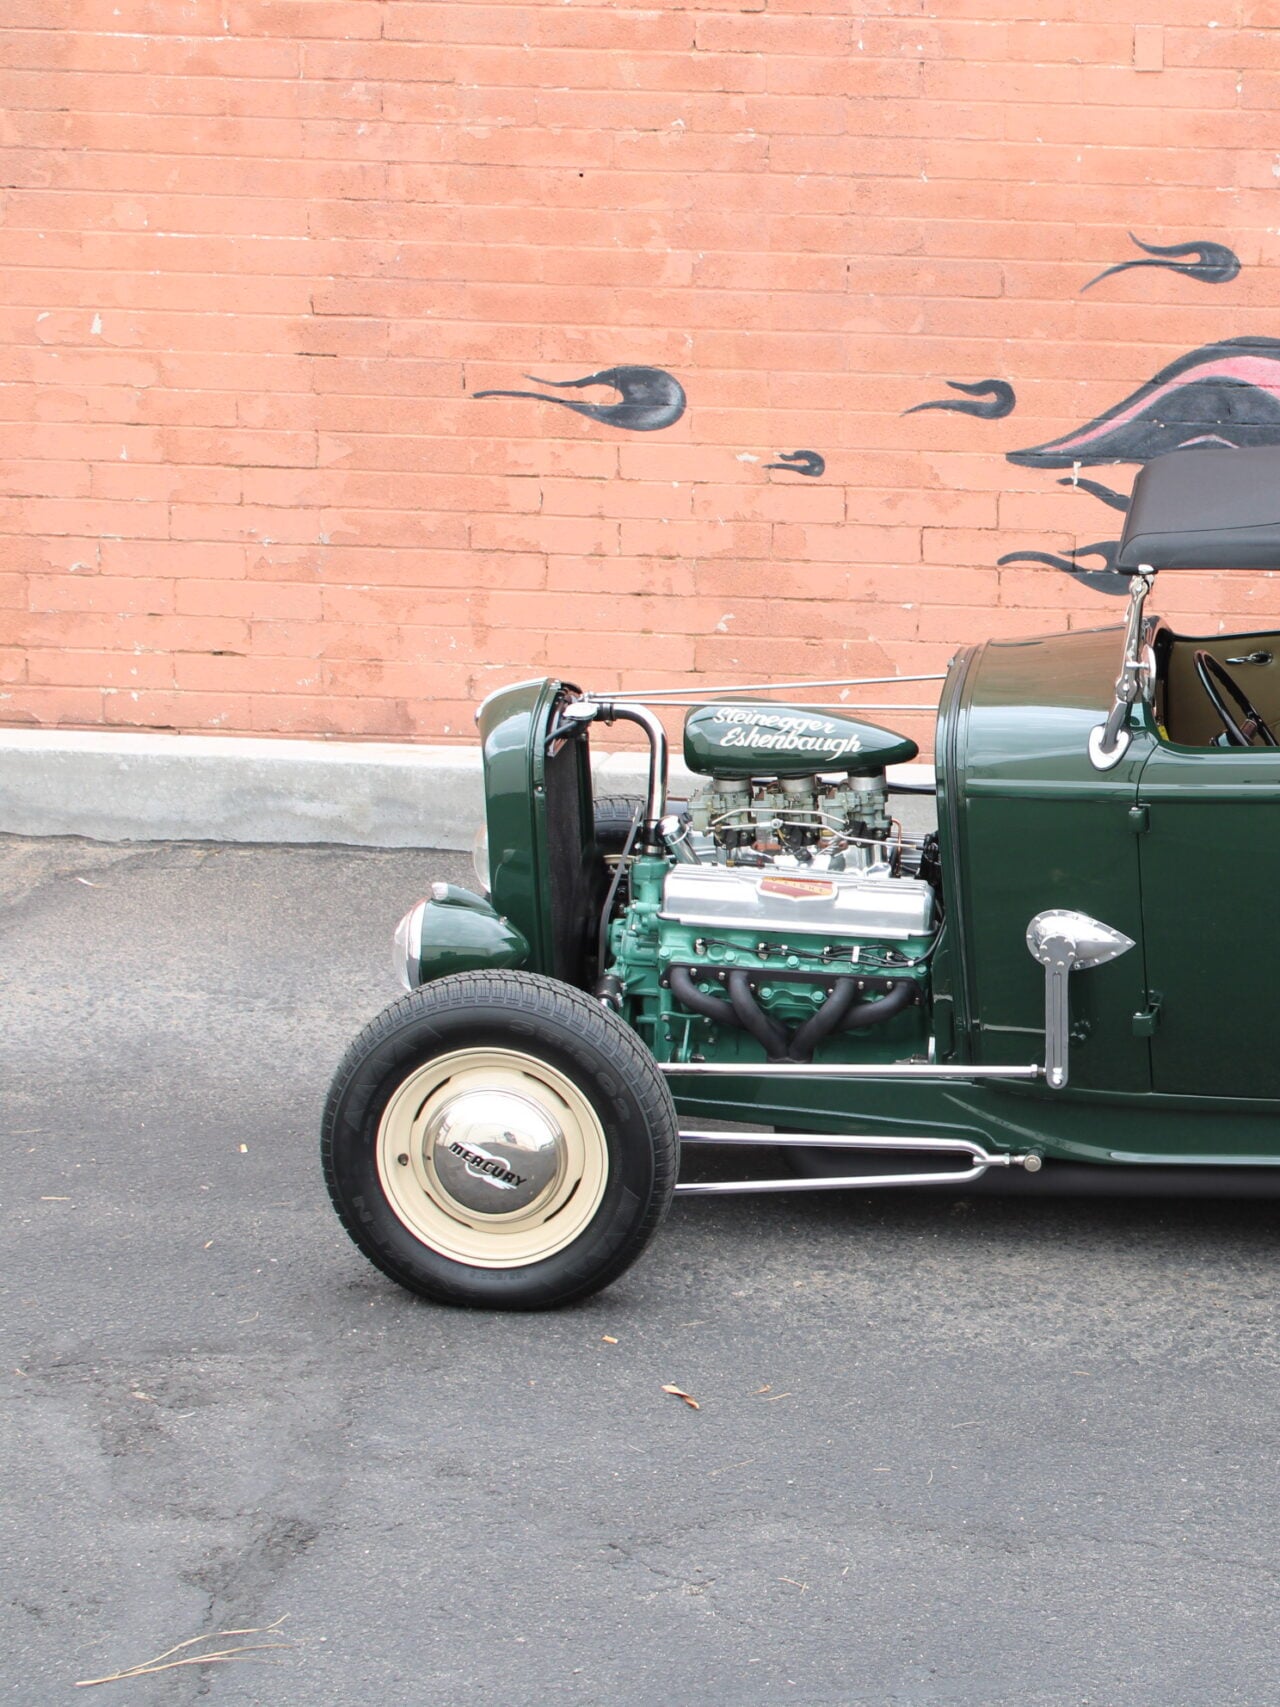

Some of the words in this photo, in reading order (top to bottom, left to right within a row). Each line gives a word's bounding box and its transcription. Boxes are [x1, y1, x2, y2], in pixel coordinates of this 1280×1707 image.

[712, 706, 836, 734] Steinegger
[719, 725, 864, 762] Eshenbaugh
[447, 1141, 528, 1187] MERCURY
